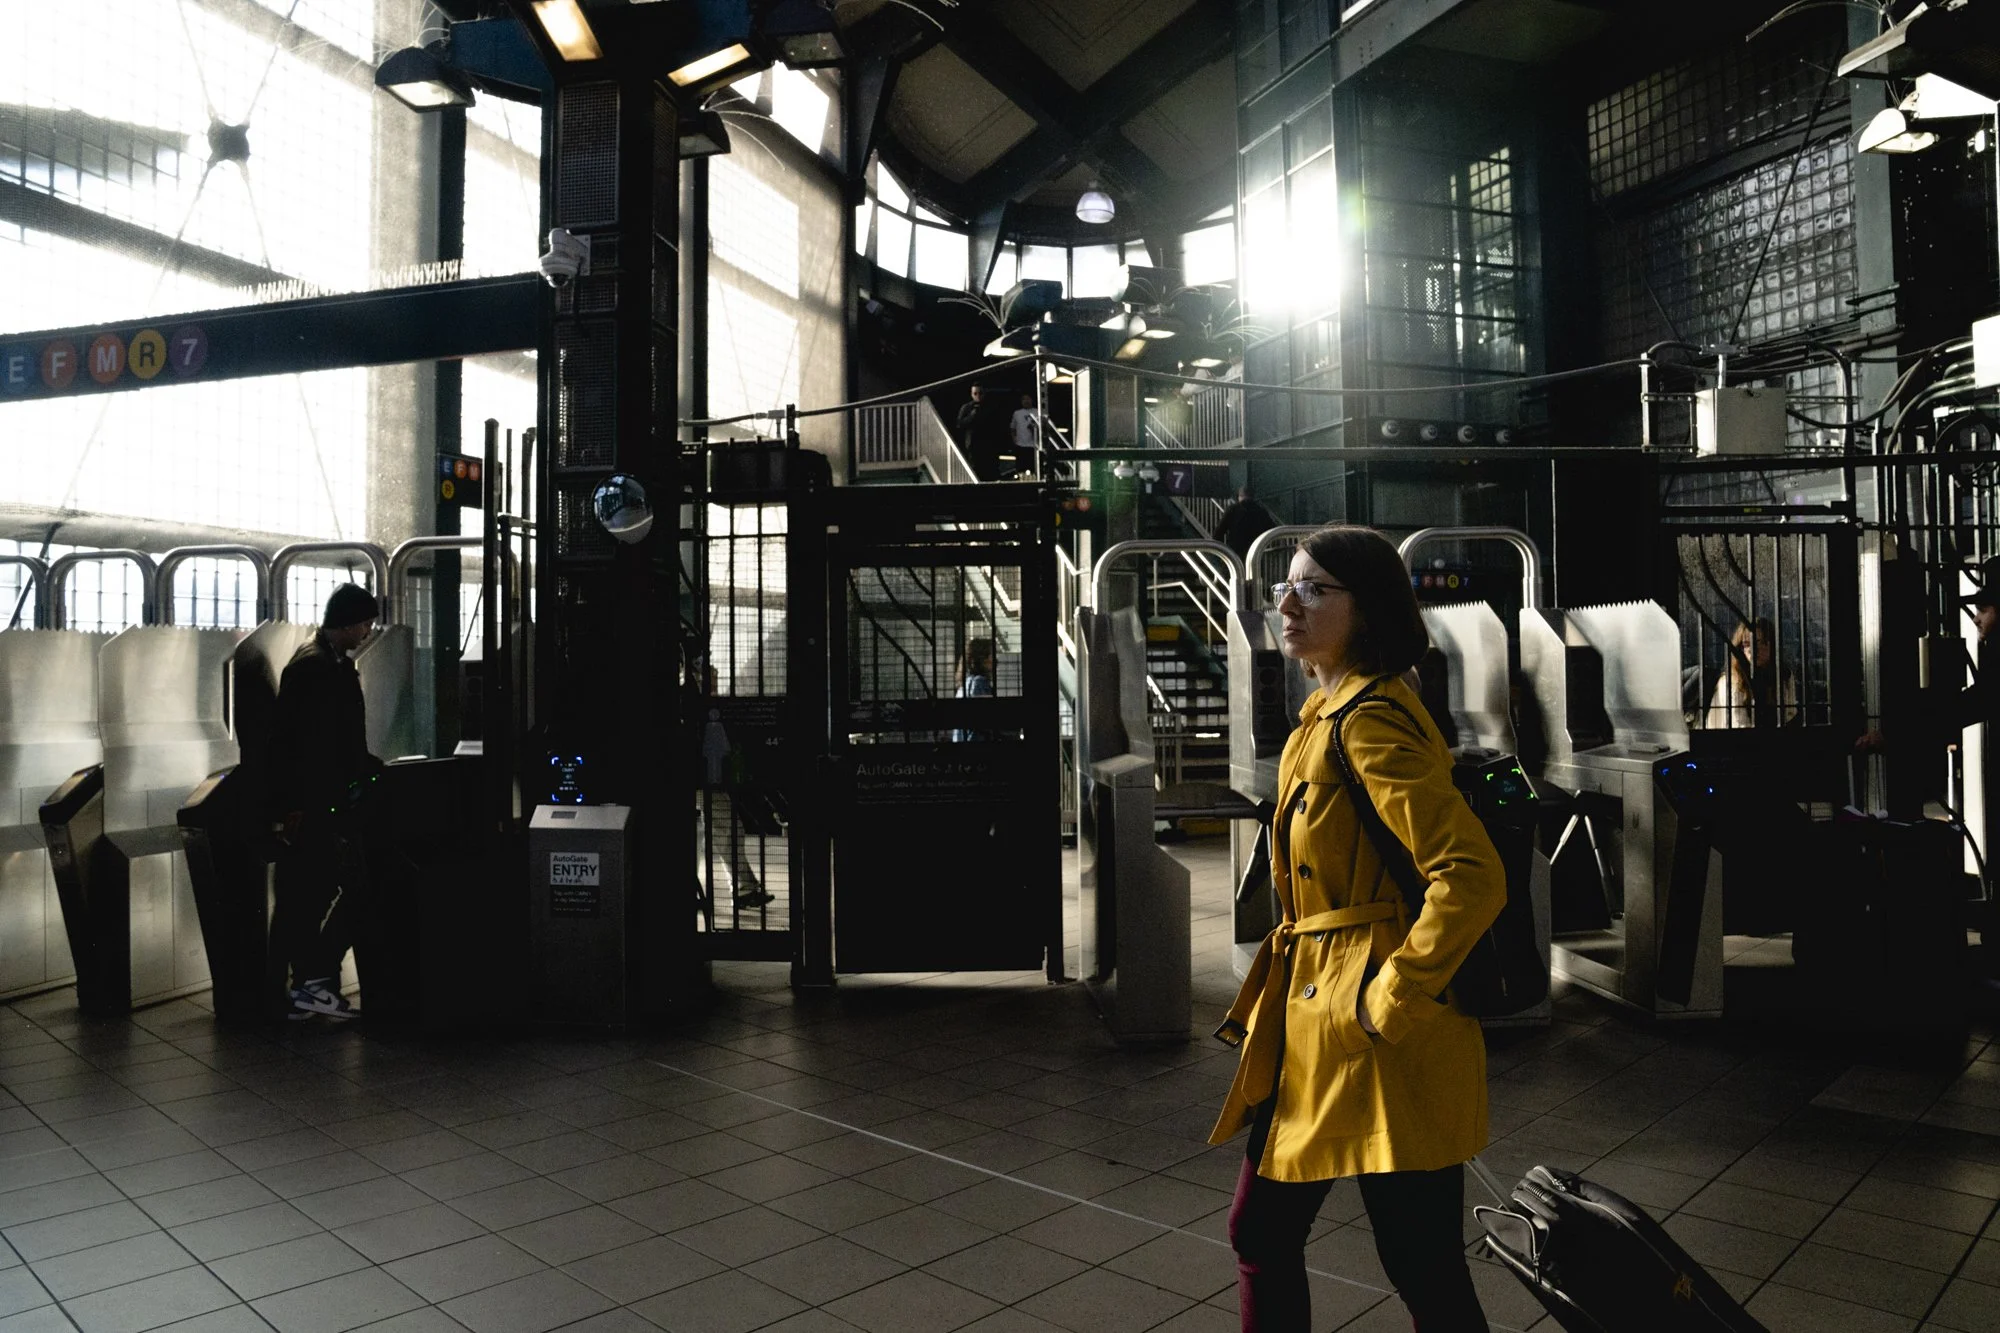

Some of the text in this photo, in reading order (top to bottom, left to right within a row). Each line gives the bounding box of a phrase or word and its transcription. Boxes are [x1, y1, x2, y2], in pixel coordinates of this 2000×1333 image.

[8, 338, 198, 384] E F M R 7
[443, 460, 451, 473] E
[1172, 471, 1184, 489] 7
[1463, 576, 1469, 586] 7
[856, 762, 927, 776] AutoGate
[552, 854, 589, 863] AutoGate
[552, 863, 597, 876] ENTRY
